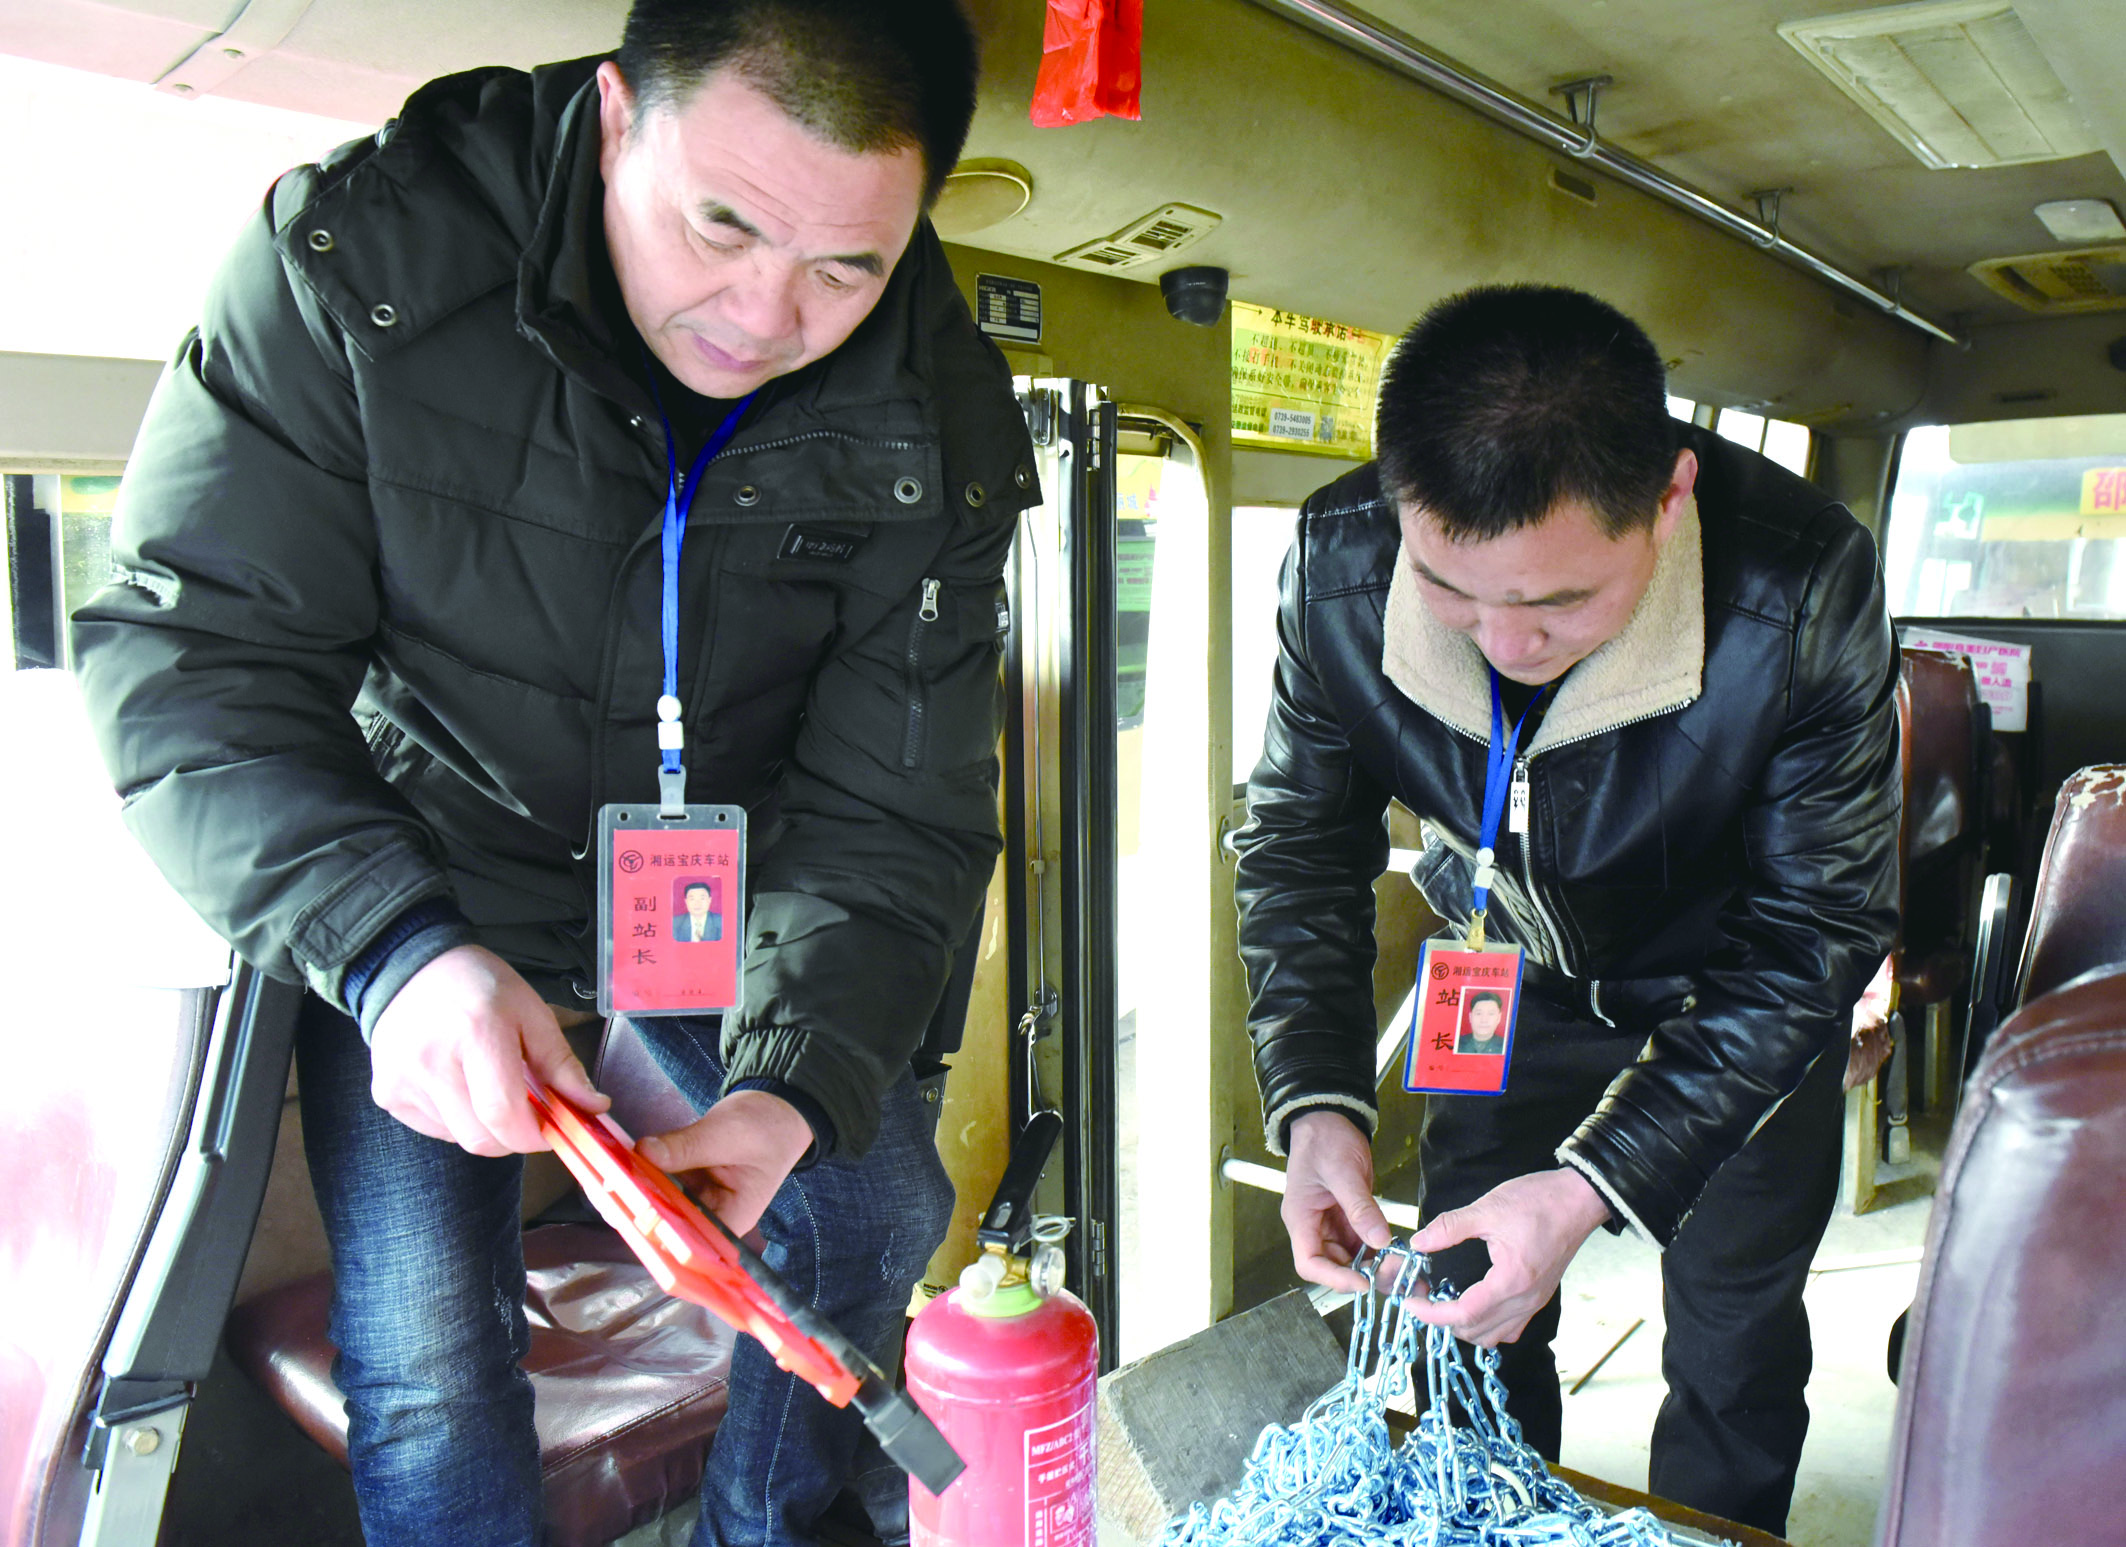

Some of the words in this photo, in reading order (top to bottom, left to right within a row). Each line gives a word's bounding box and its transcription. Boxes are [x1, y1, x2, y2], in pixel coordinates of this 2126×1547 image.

[650, 854, 729, 867] 湘运宝庆车站
[632, 896, 657, 964] 副站长
[1453, 966, 1510, 978] 湘运宝庆车站
[1431, 988, 1460, 1051] 站长
